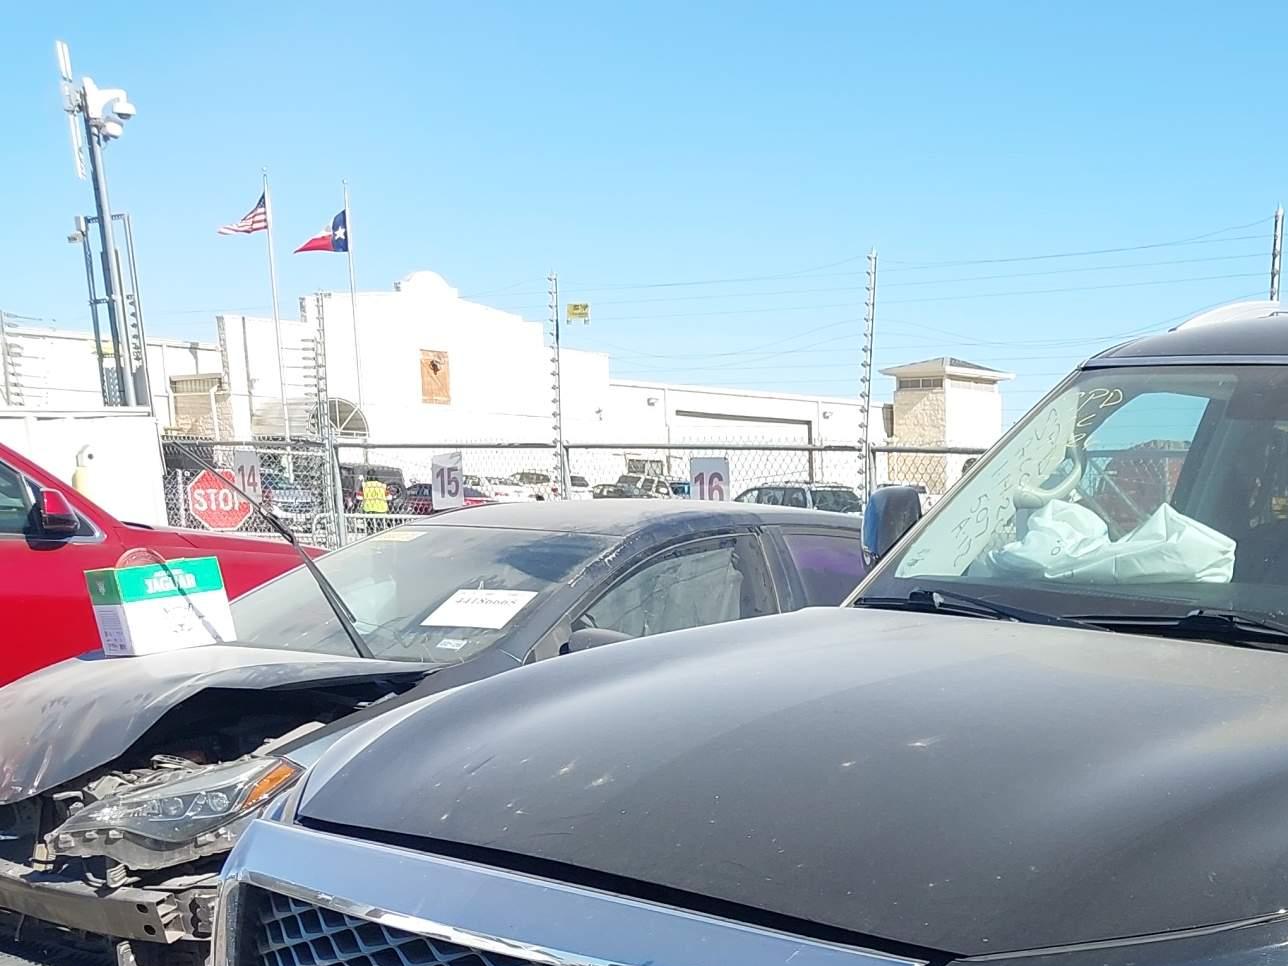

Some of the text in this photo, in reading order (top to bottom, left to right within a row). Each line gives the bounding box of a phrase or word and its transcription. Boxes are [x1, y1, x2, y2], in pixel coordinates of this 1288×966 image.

[238, 465, 258, 493] 14
[436, 467, 460, 498] 15
[694, 472, 724, 501] 16
